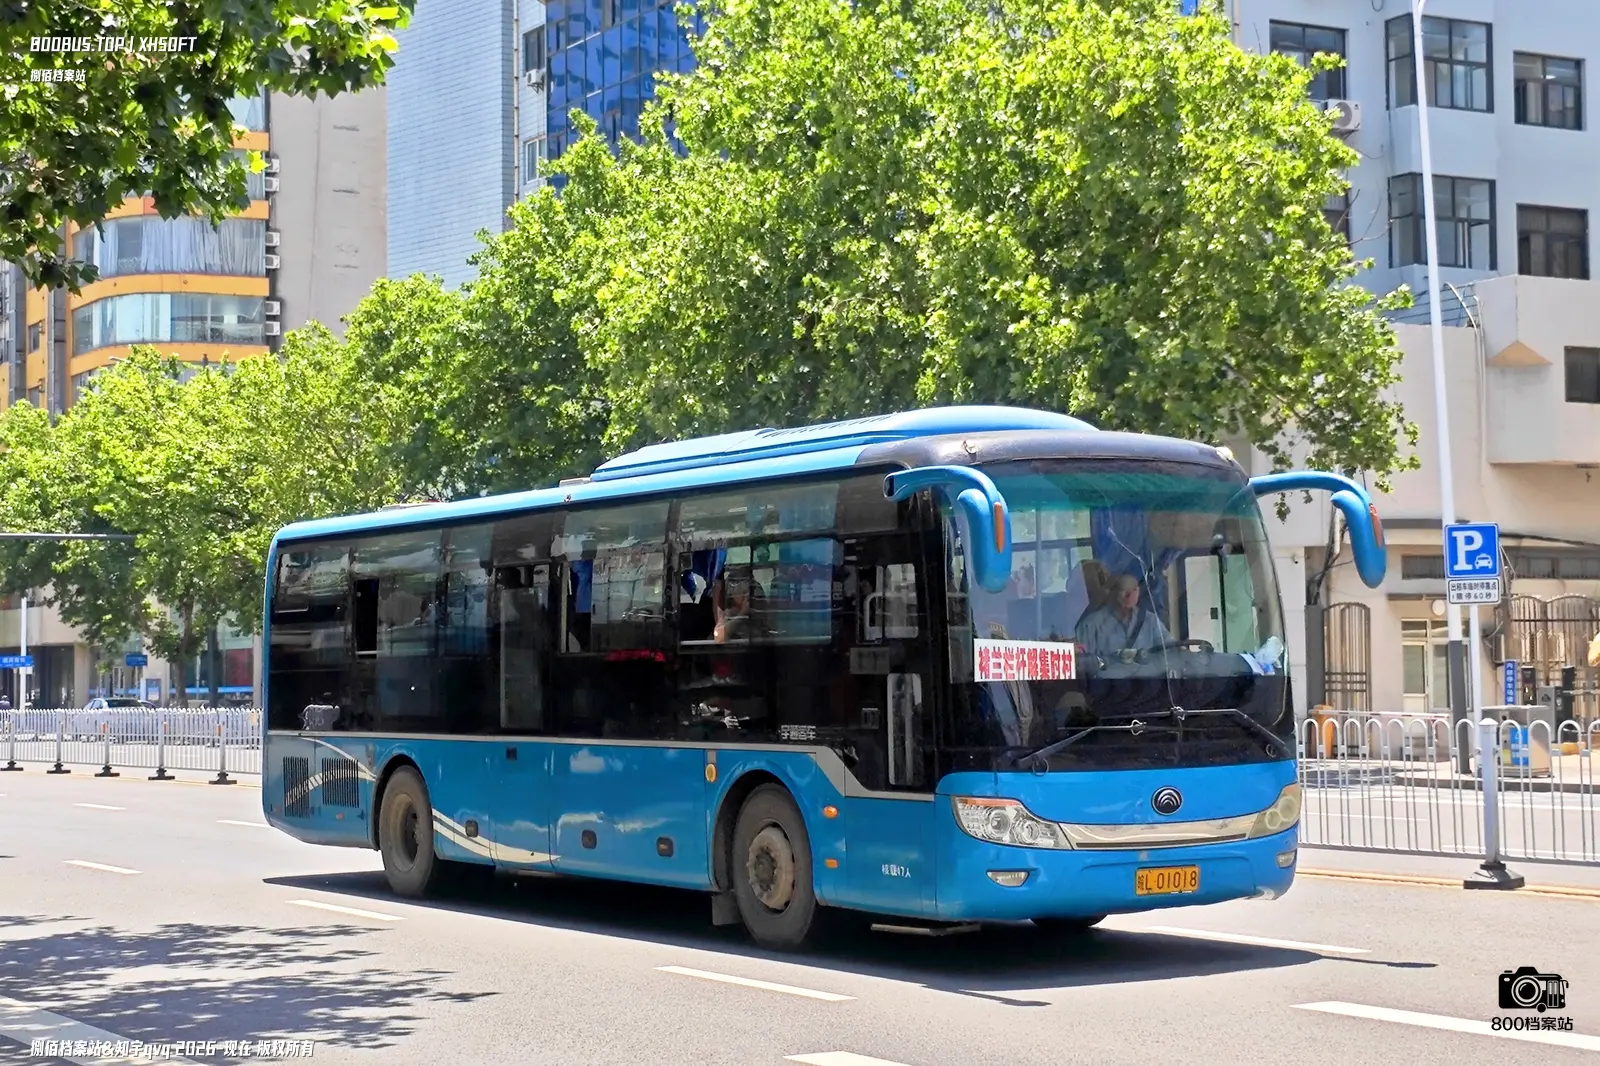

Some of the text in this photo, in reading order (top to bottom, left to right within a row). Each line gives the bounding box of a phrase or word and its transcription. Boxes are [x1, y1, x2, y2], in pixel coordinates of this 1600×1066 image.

[1451, 530, 1483, 571] P
[780, 724, 817, 741] 宇通客车
